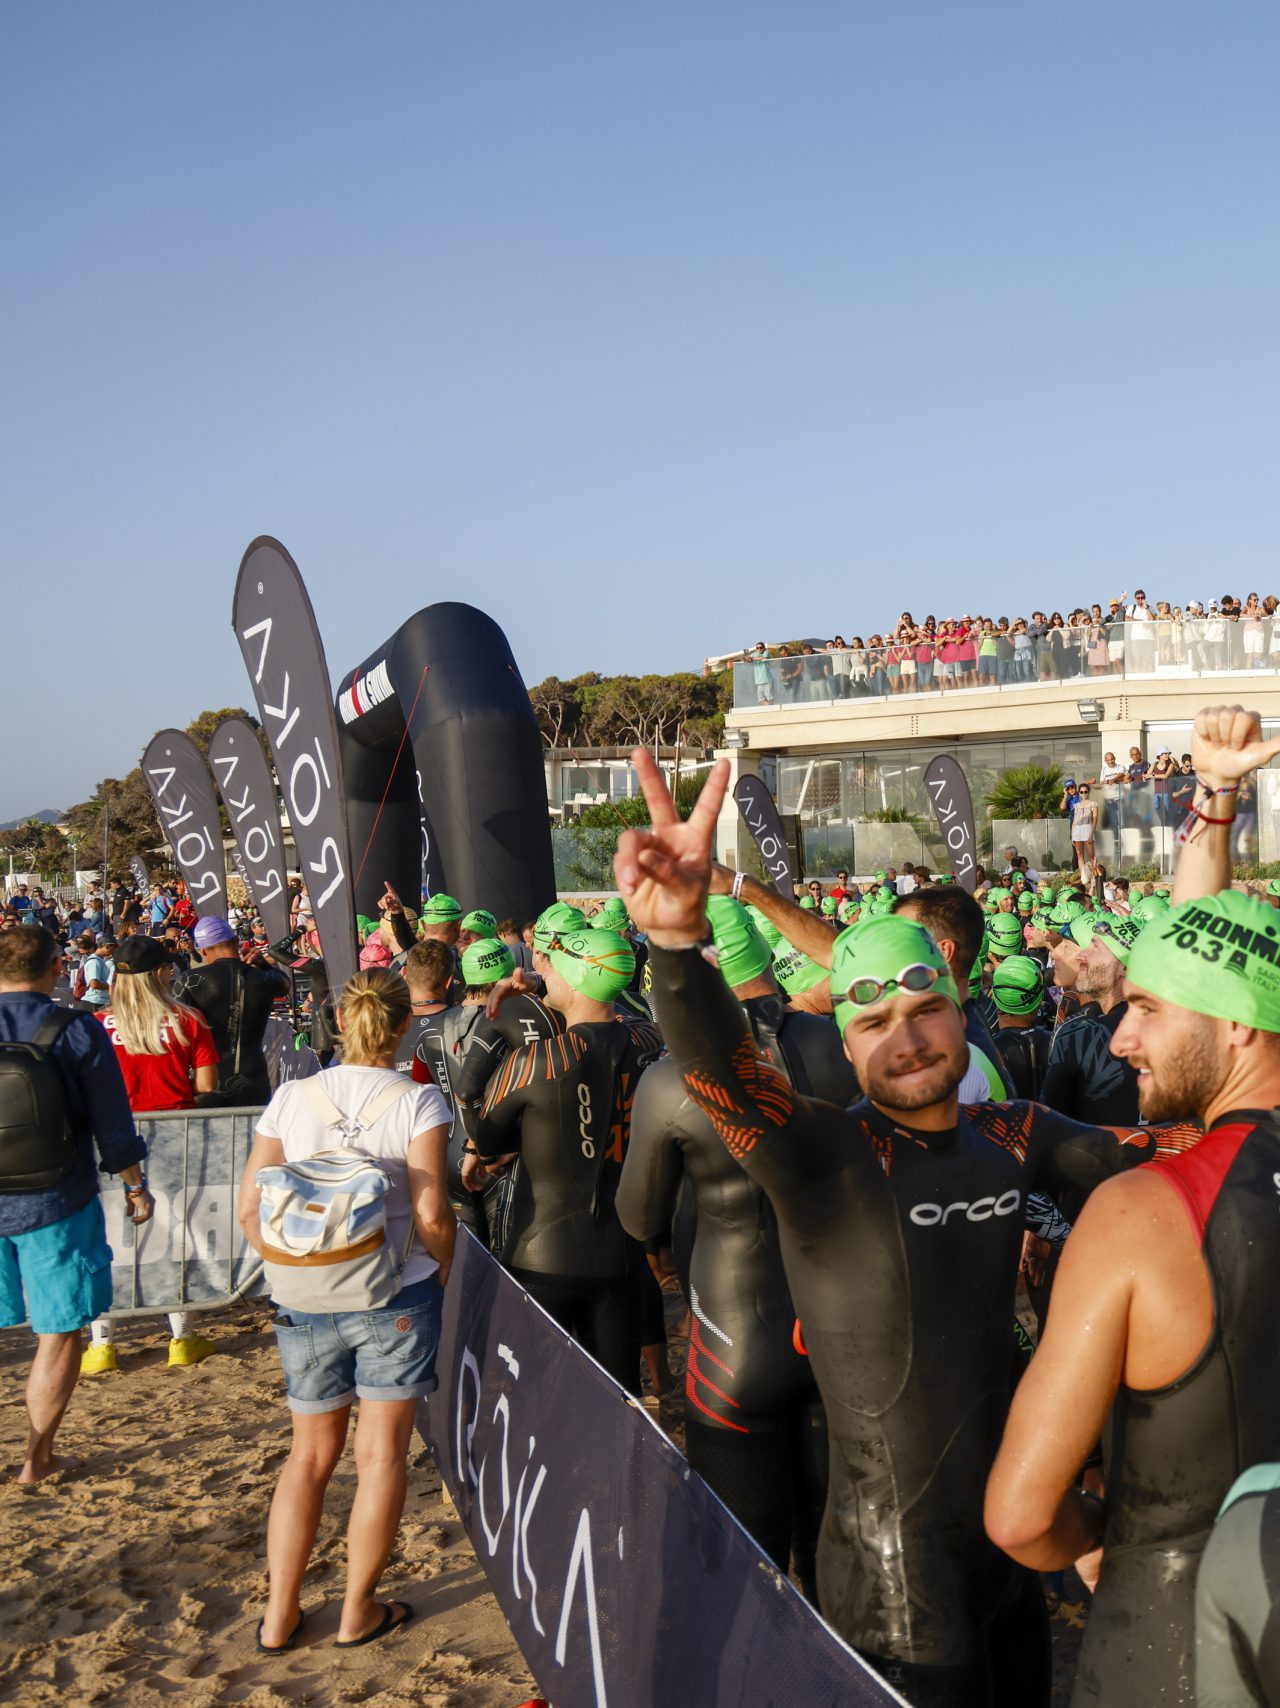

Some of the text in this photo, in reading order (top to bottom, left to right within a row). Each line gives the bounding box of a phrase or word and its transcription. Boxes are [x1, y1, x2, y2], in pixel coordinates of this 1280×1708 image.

[1160, 922, 1224, 963] 70.3
[478, 959, 499, 970] 70.3
[435, 1061, 450, 1094] HUUB
[577, 1083, 595, 1159] orca
[910, 1189, 1021, 1227] orca
